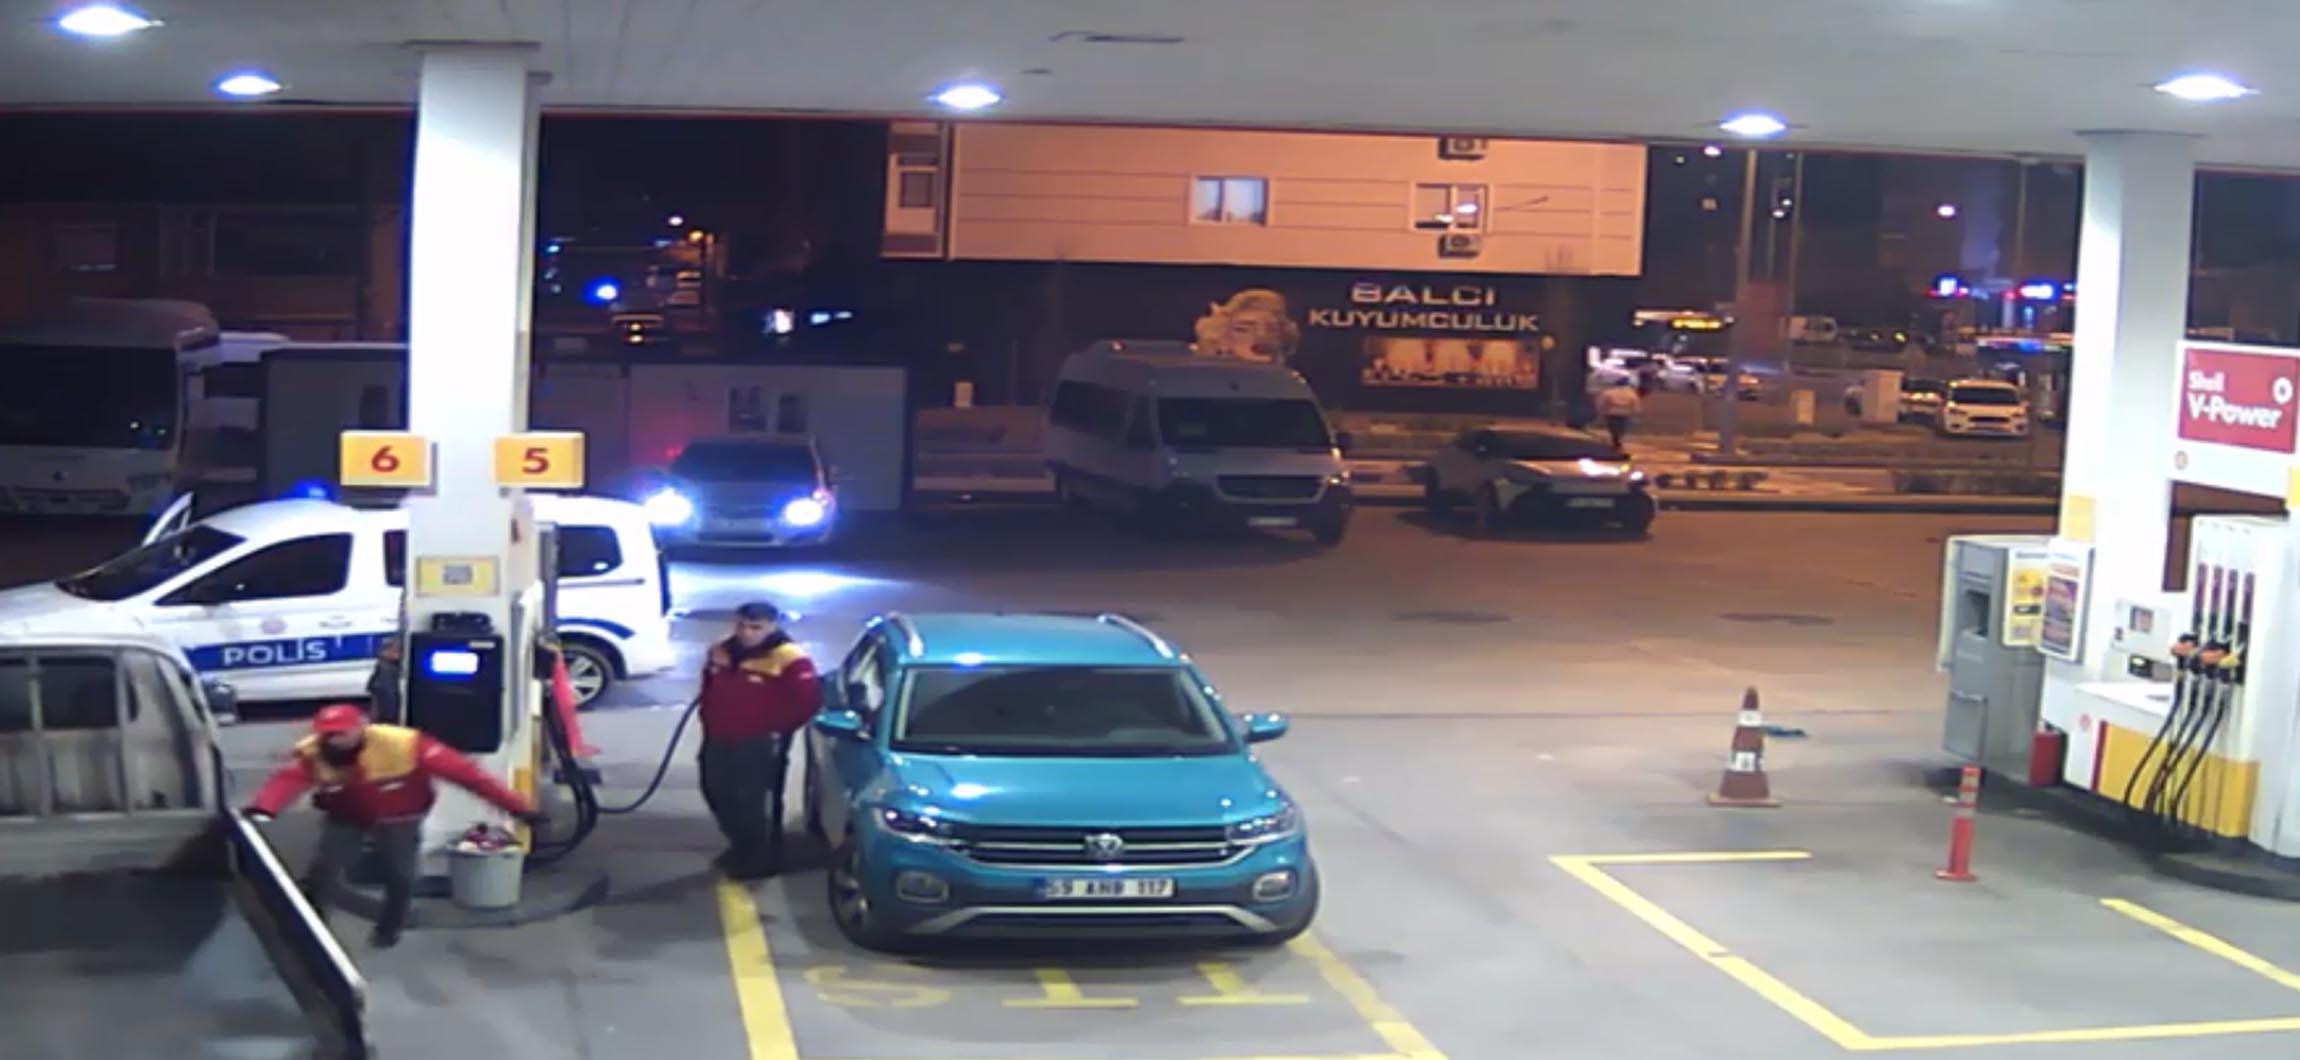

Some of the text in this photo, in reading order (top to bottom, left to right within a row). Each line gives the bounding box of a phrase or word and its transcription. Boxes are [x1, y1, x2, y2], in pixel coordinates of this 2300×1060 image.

[1352, 282, 1496, 306] BALCI
[1308, 308, 1540, 331] KUYUMCULUK
[2187, 391, 2283, 429] V-Power
[370, 445, 400, 473] 6
[522, 447, 550, 475] 5
